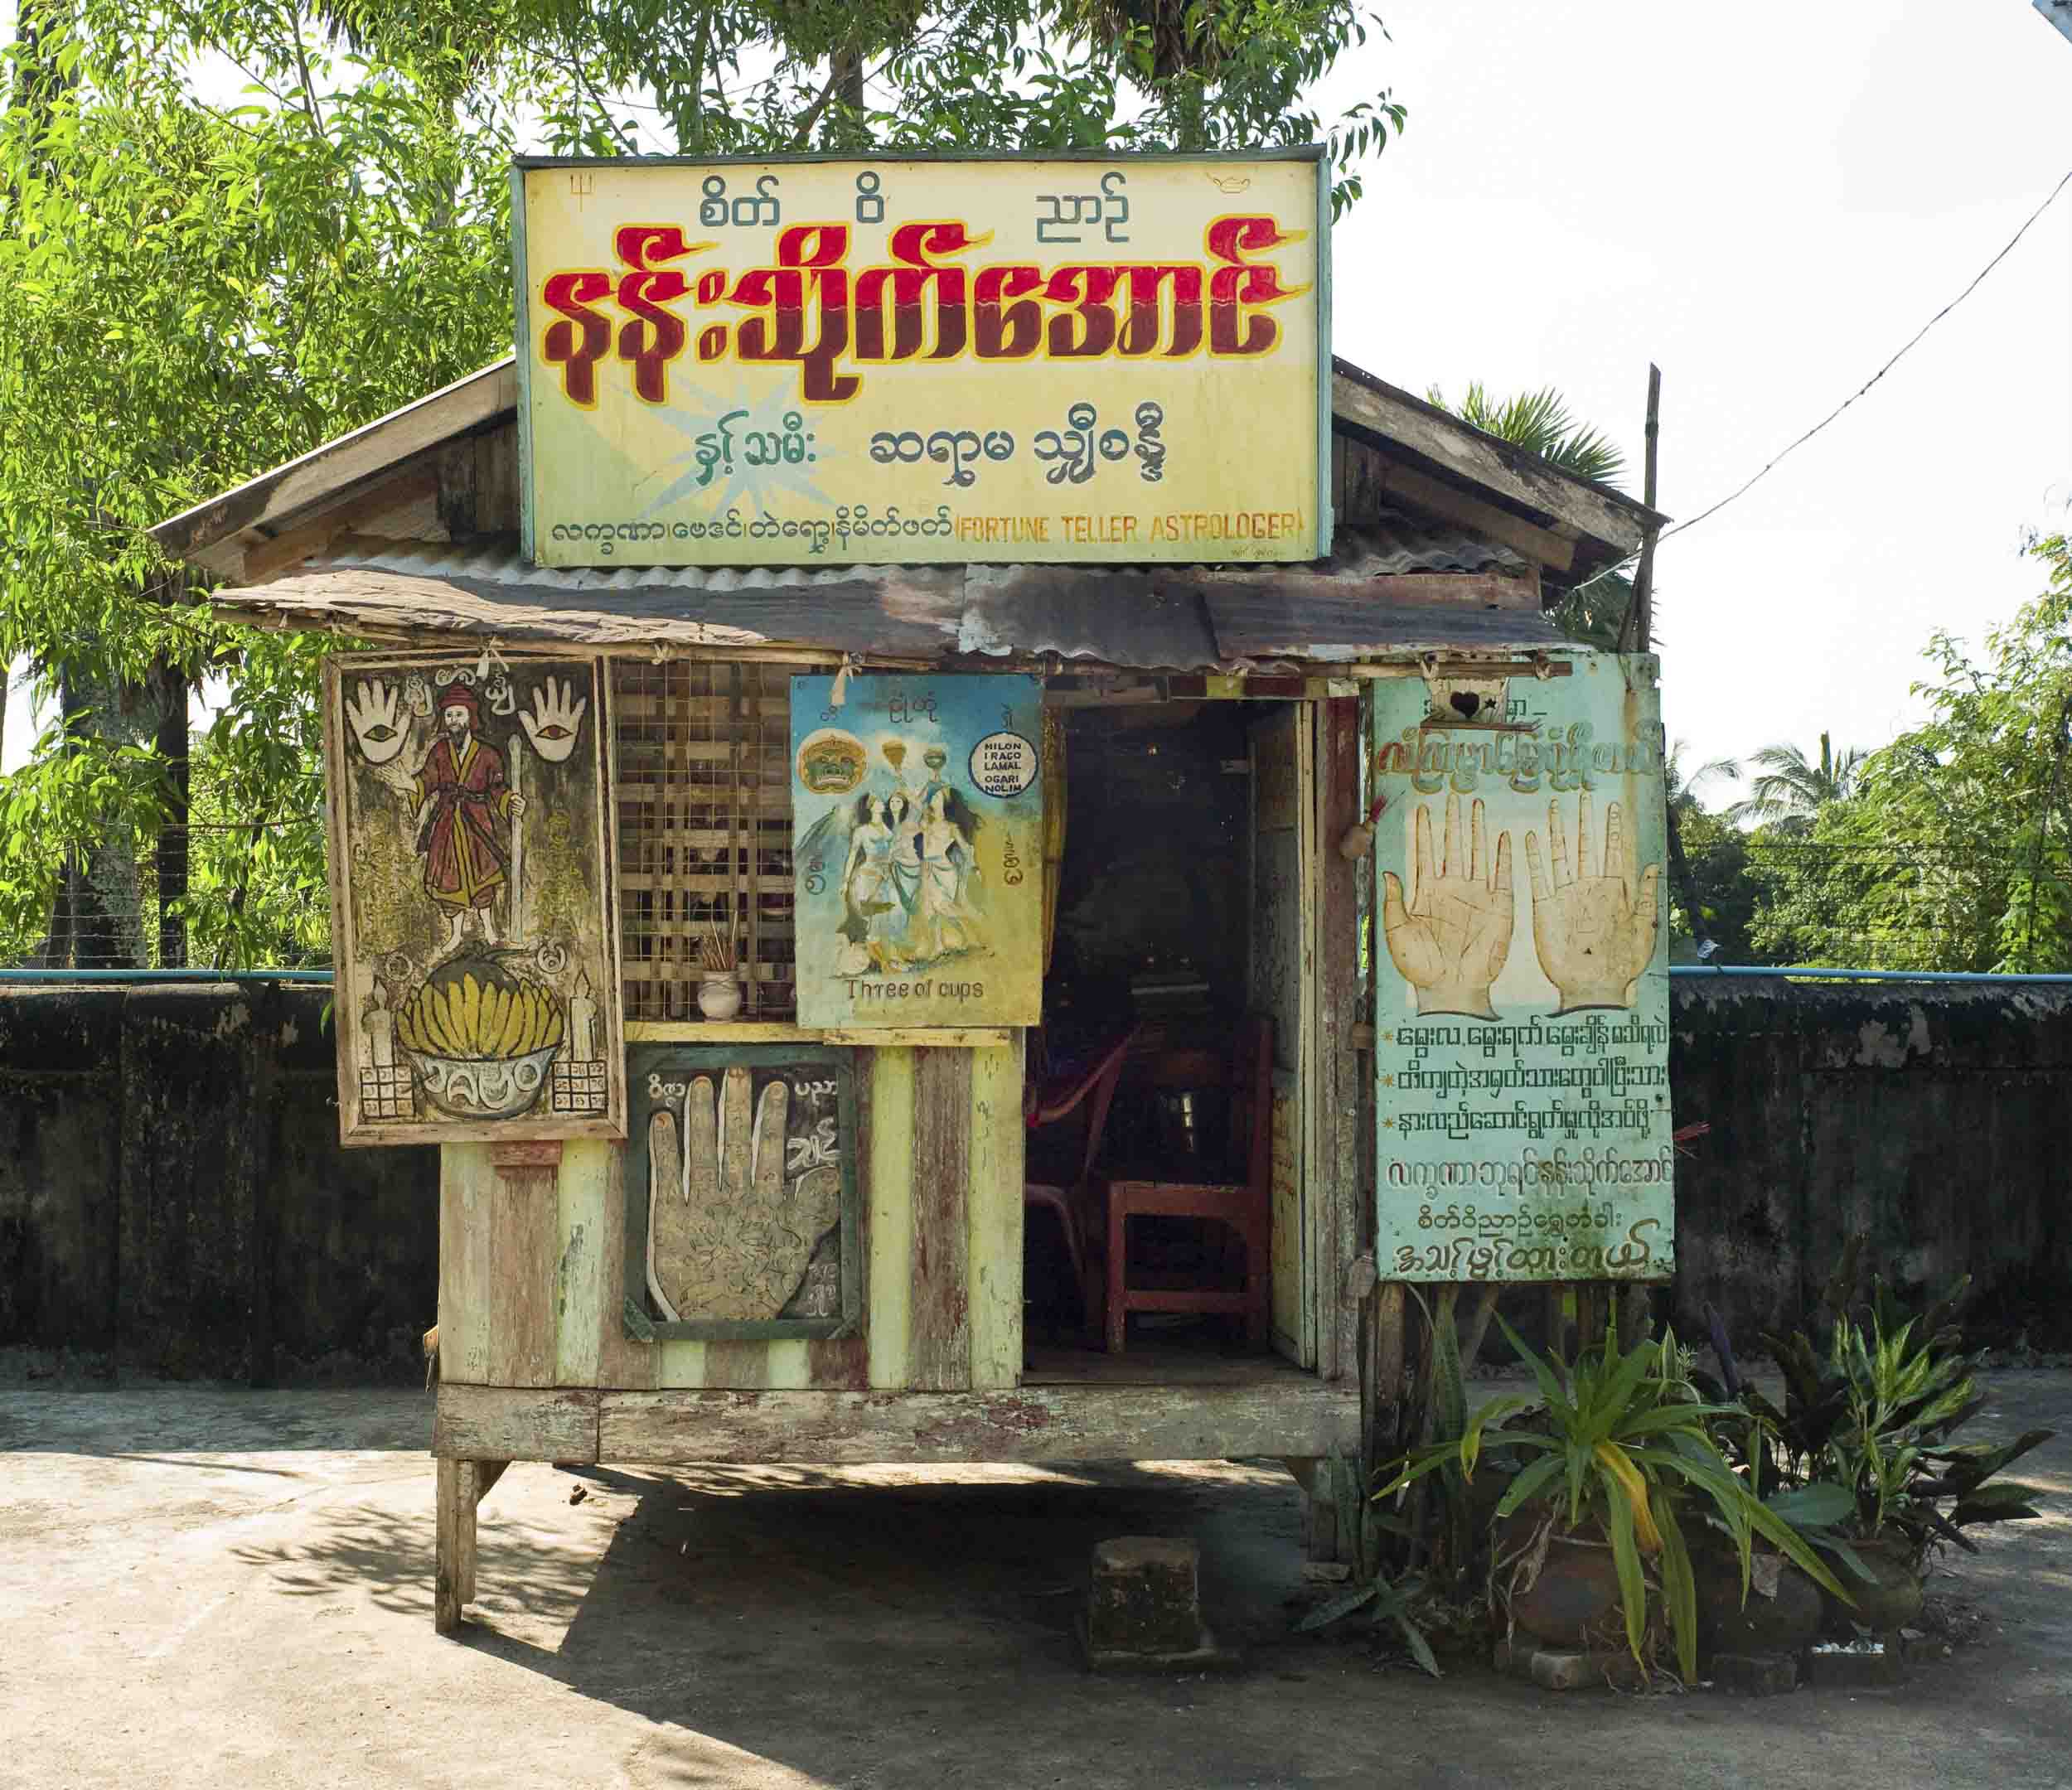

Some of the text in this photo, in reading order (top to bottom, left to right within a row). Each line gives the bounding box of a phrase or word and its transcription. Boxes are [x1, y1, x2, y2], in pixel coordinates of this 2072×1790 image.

[700, 173, 781, 227] စိတ်
[1061, 514, 1138, 544] TELLER
[984, 775, 1019, 783] OGARI
[984, 784, 1022, 792] NOLIM
[846, 980, 985, 1002] Three of cups
